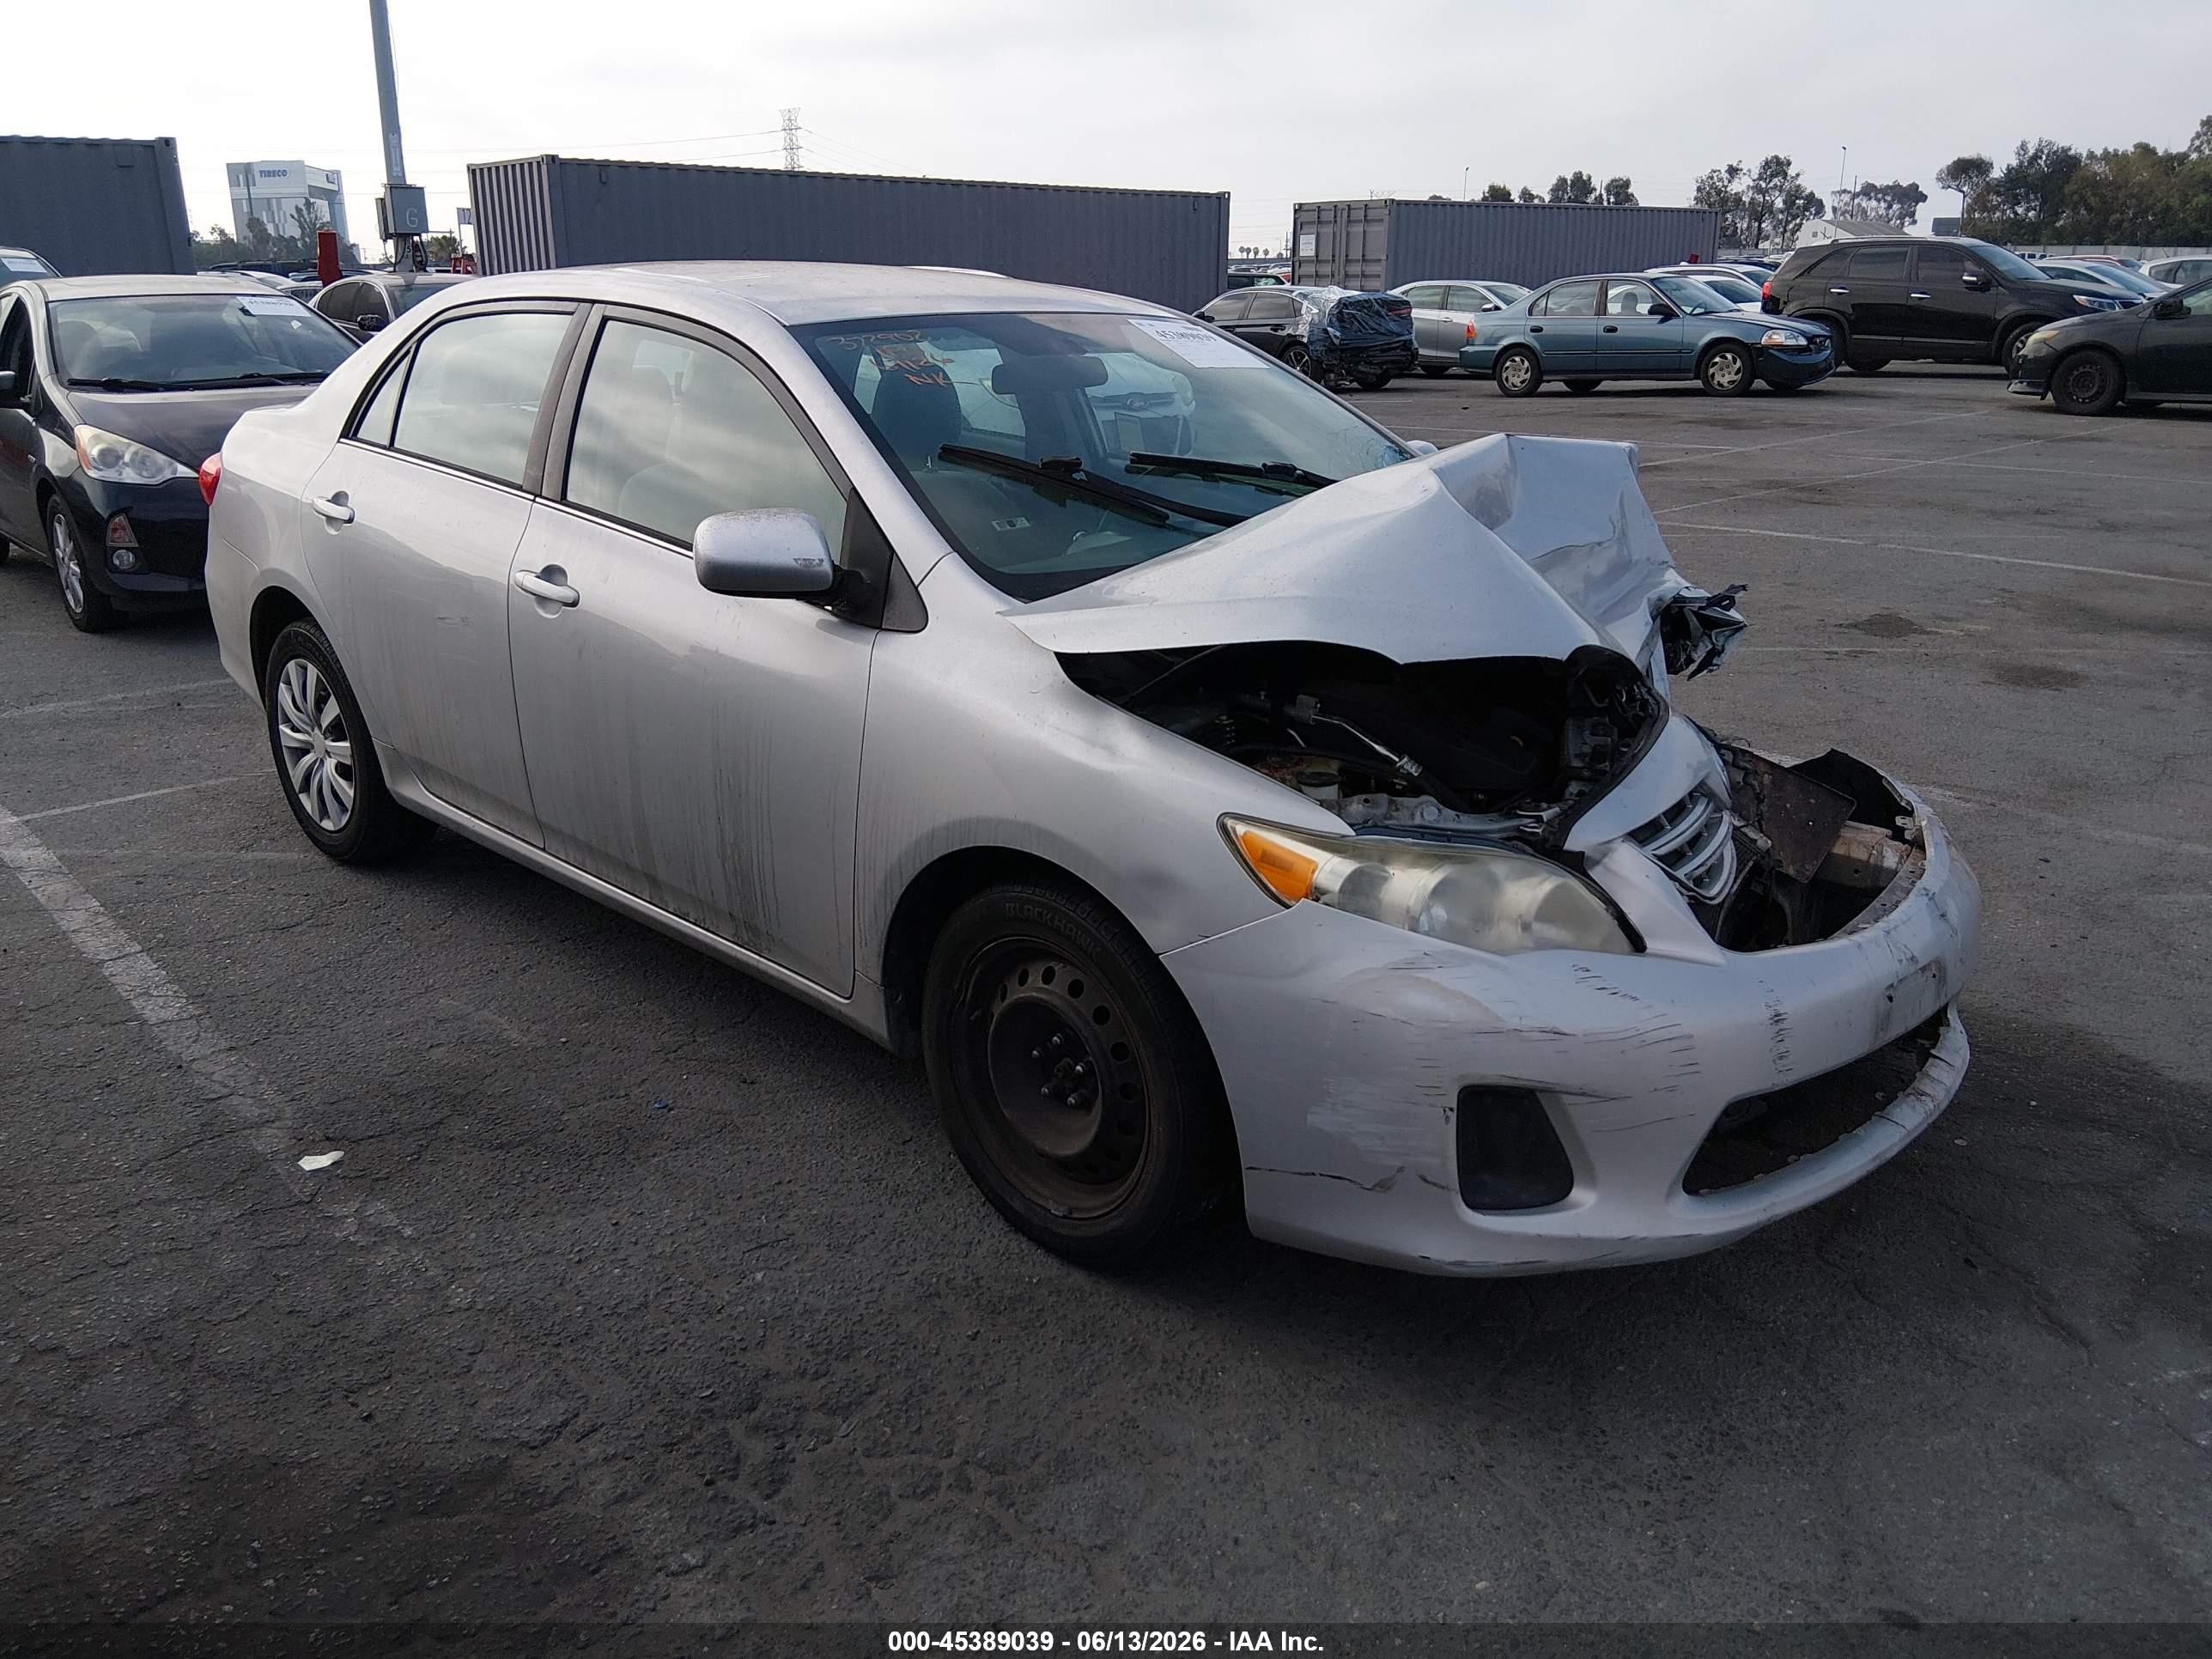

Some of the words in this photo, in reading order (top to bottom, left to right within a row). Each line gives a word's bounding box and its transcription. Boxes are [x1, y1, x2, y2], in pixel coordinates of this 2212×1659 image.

[259, 169, 288, 178] TIRECO
[406, 208, 418, 228] G
[1005, 902, 1102, 962] BLACKHAWK
